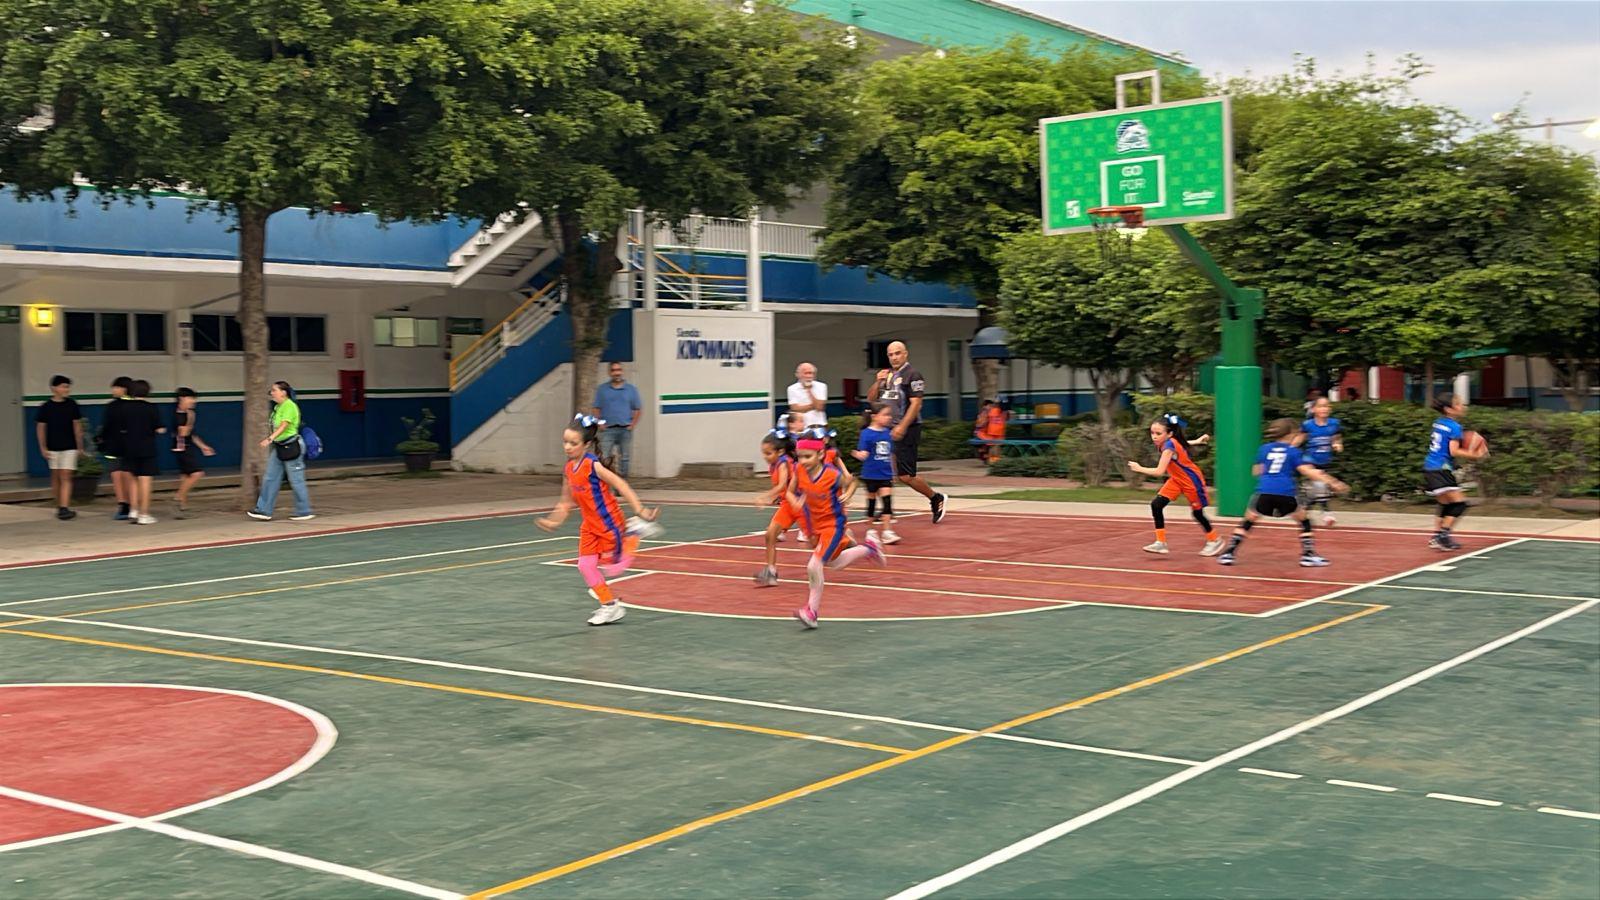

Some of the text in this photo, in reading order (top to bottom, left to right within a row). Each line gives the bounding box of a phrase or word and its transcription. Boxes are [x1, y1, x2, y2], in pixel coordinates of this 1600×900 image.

[1121, 165, 1143, 177] GO
[1119, 178, 1146, 190] FOR
[1124, 192, 1140, 203] IT
[1430, 432, 1442, 452] 3
[1266, 453, 1287, 473] 7
